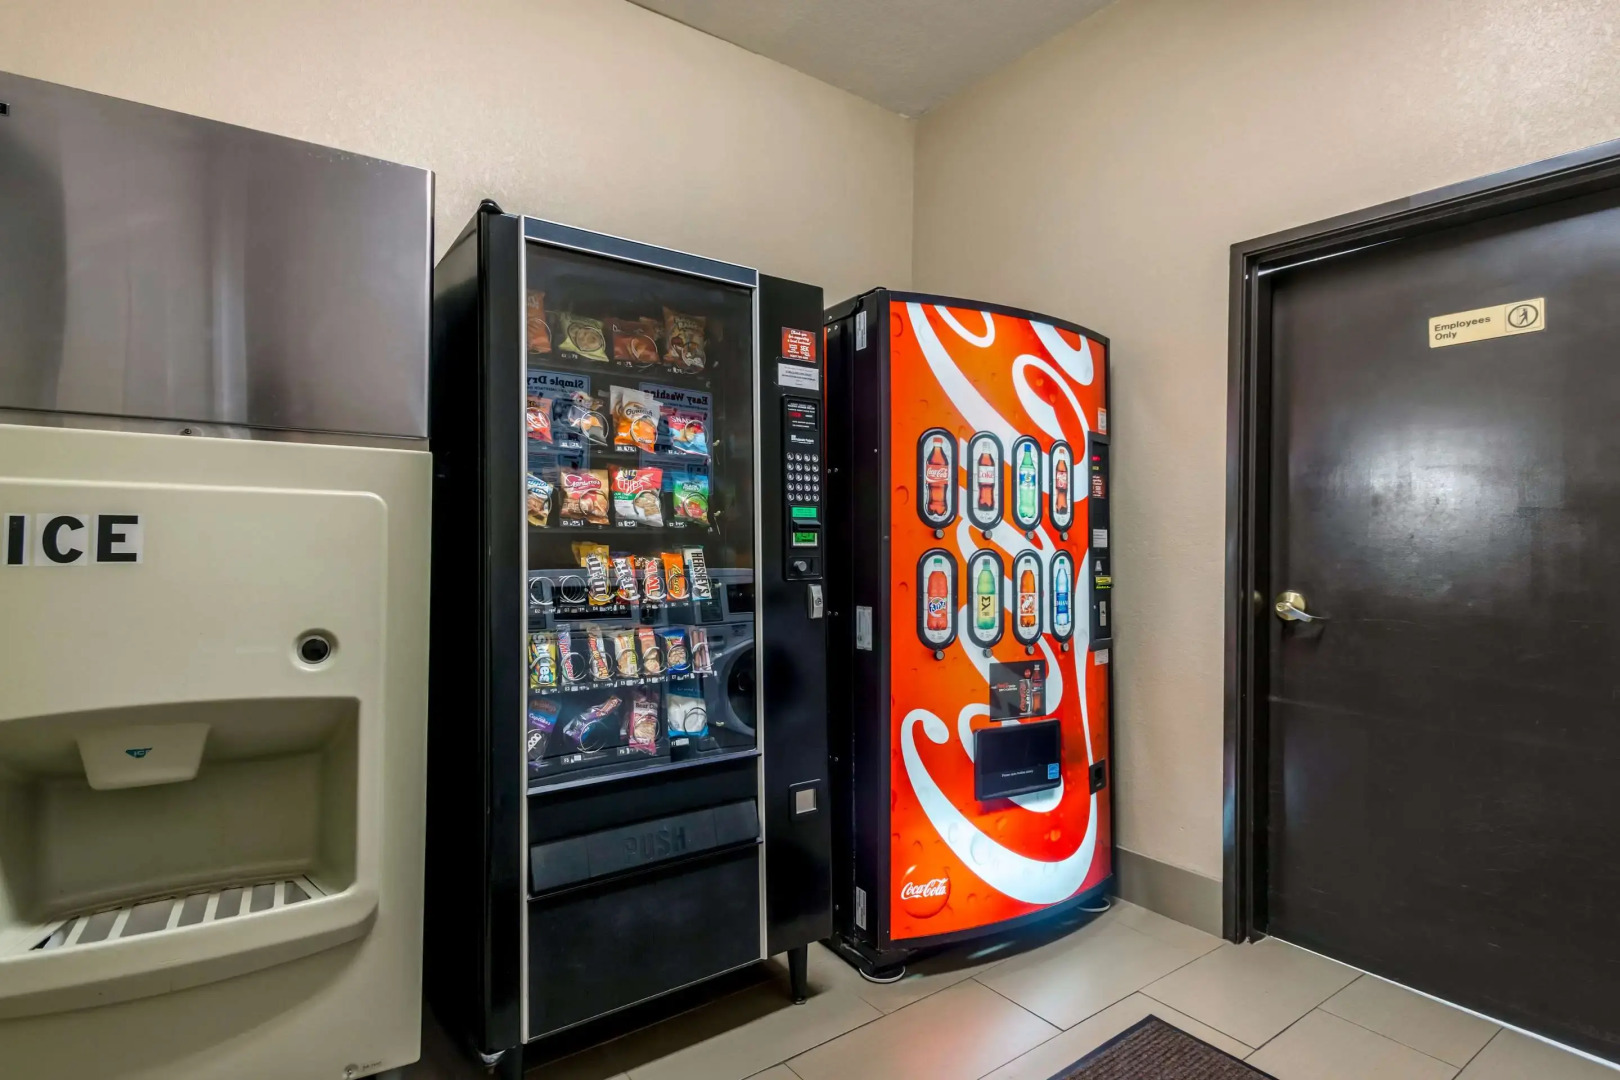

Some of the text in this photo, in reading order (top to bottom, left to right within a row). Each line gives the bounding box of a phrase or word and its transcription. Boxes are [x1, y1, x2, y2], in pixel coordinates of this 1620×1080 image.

[1434, 316, 1491, 332] Employees
[1434, 331, 1457, 341] Only
[926, 467, 948, 478] Coca-Cola
[8, 515, 138, 564] ICE
[901, 878, 949, 900] Coca-Cola
